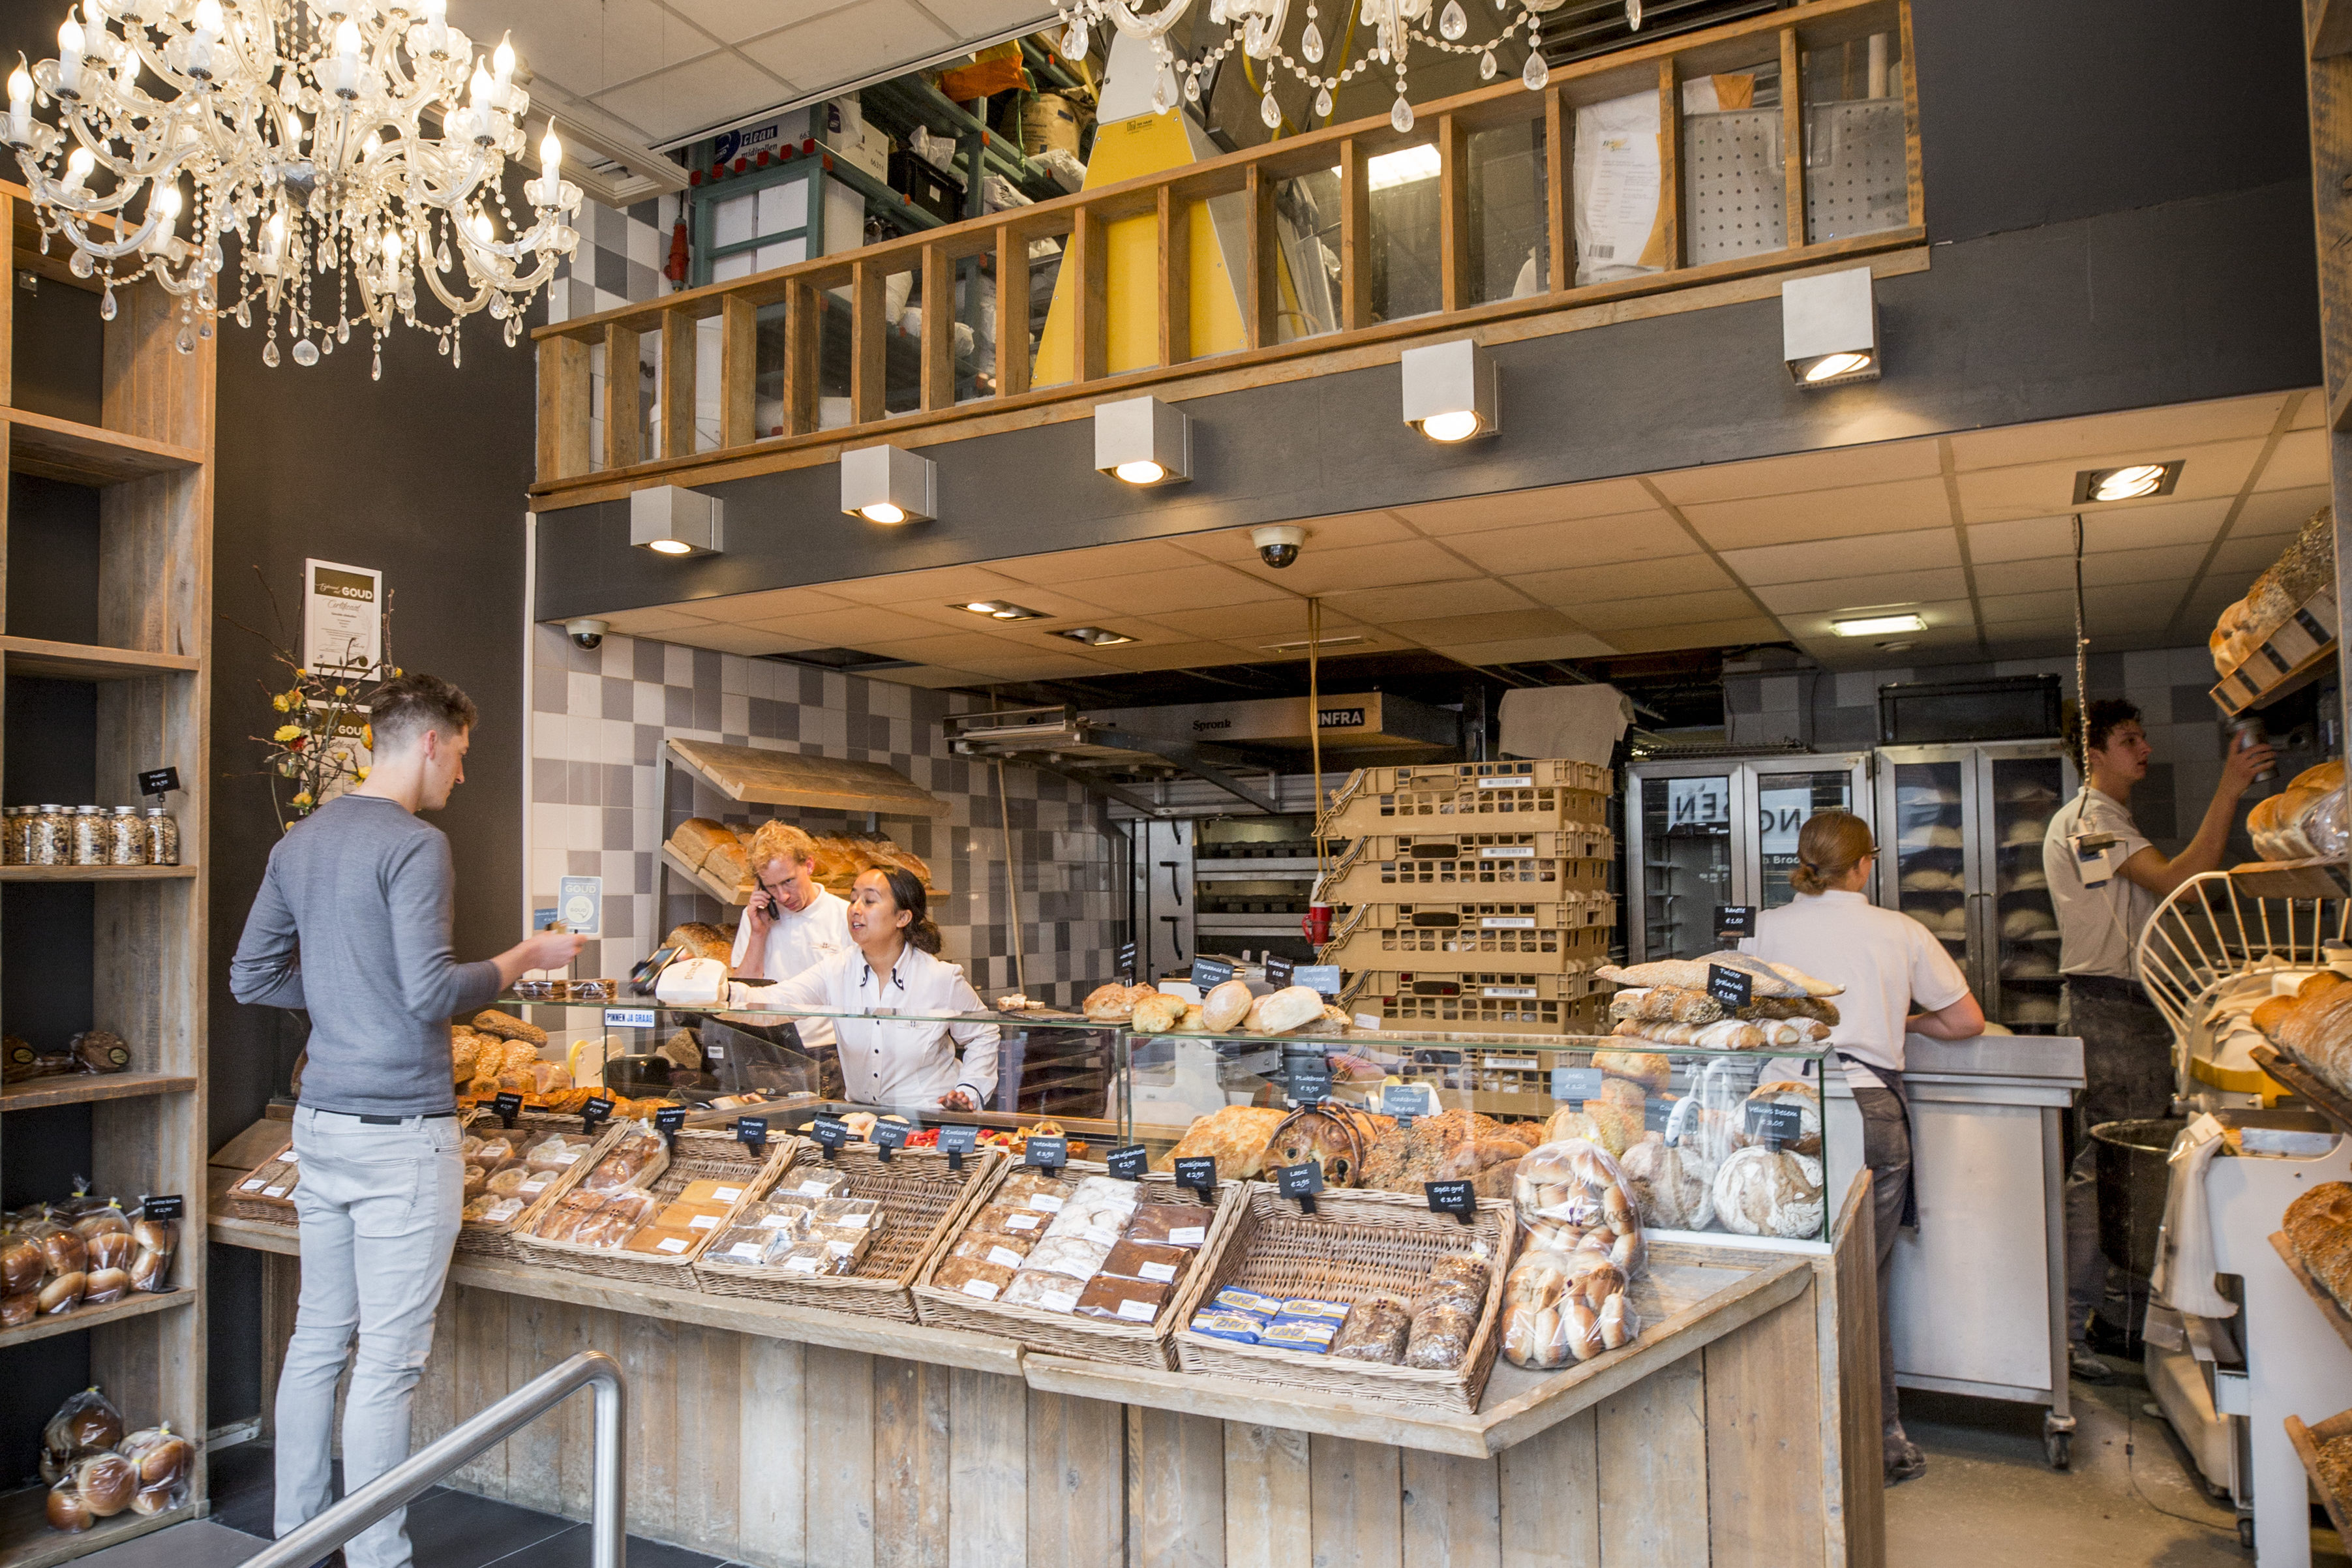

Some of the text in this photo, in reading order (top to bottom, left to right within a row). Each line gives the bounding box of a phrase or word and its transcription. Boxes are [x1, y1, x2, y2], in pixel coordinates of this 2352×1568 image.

[744, 126, 776, 145] clean
[870, 157, 884, 172] 66311
[342, 586, 373, 599] GOUD
[1318, 711, 1362, 725] INFRA
[338, 725, 362, 736] GOU
[1192, 719, 1231, 732] Spronk
[1773, 855, 1800, 864] Broo
[565, 884, 596, 894] GOUD
[607, 1013, 653, 1023] PINNEN JA GRAAG
[1224, 1293, 1256, 1305] LANZ
[1271, 1327, 1306, 1336] LANZ
